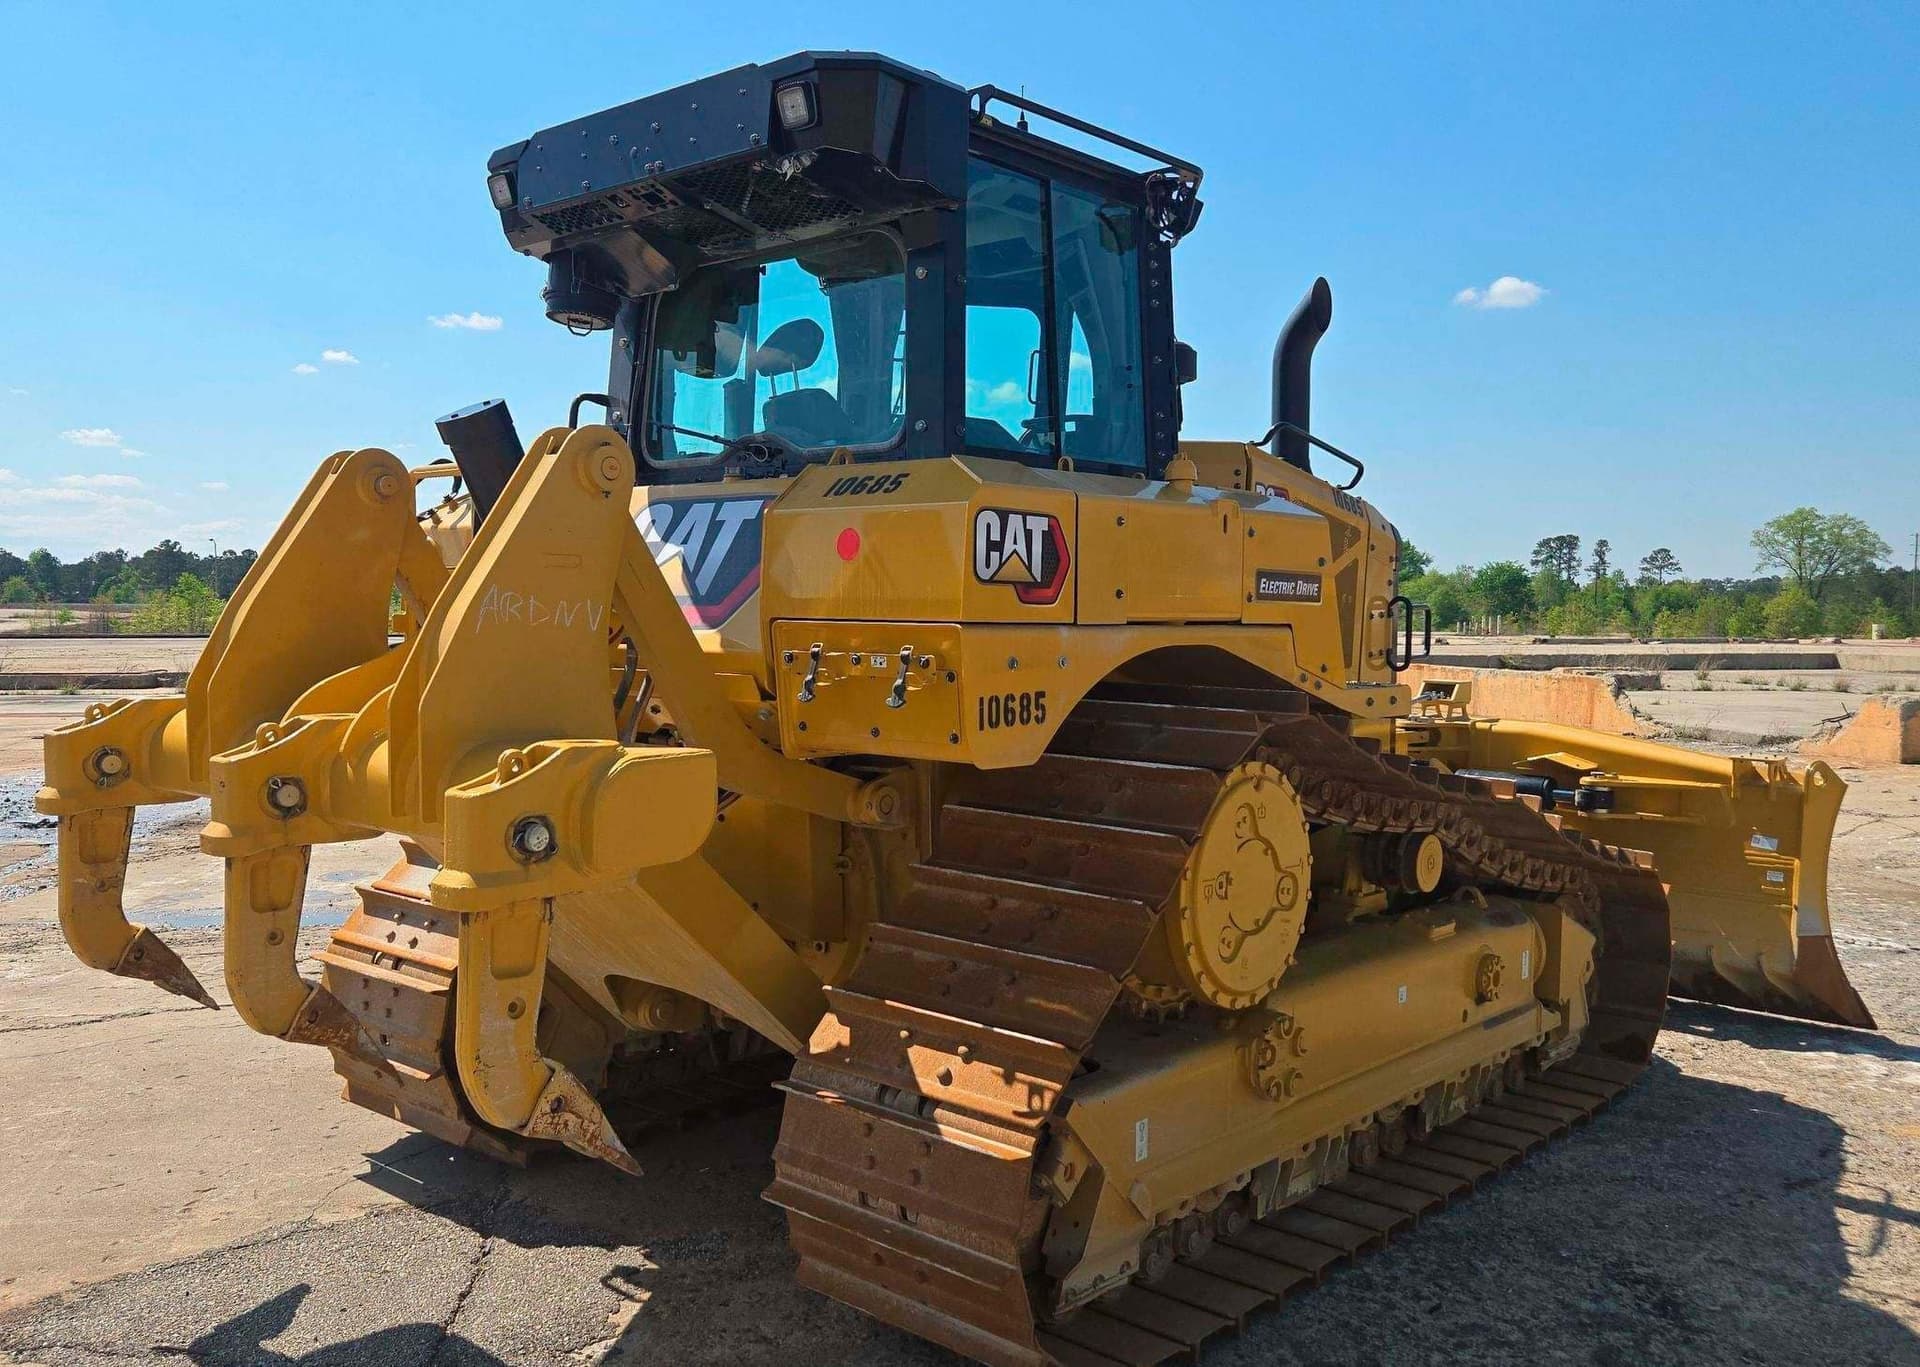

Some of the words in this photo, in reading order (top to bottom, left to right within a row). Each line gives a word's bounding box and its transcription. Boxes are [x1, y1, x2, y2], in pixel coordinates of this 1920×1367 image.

[823, 473, 911, 497] 10685
[976, 510, 1048, 582] CAT
[1259, 578, 1296, 595] ELECTRIC
[1296, 580, 1320, 596] DRIVE
[978, 691, 1046, 731] 10685
